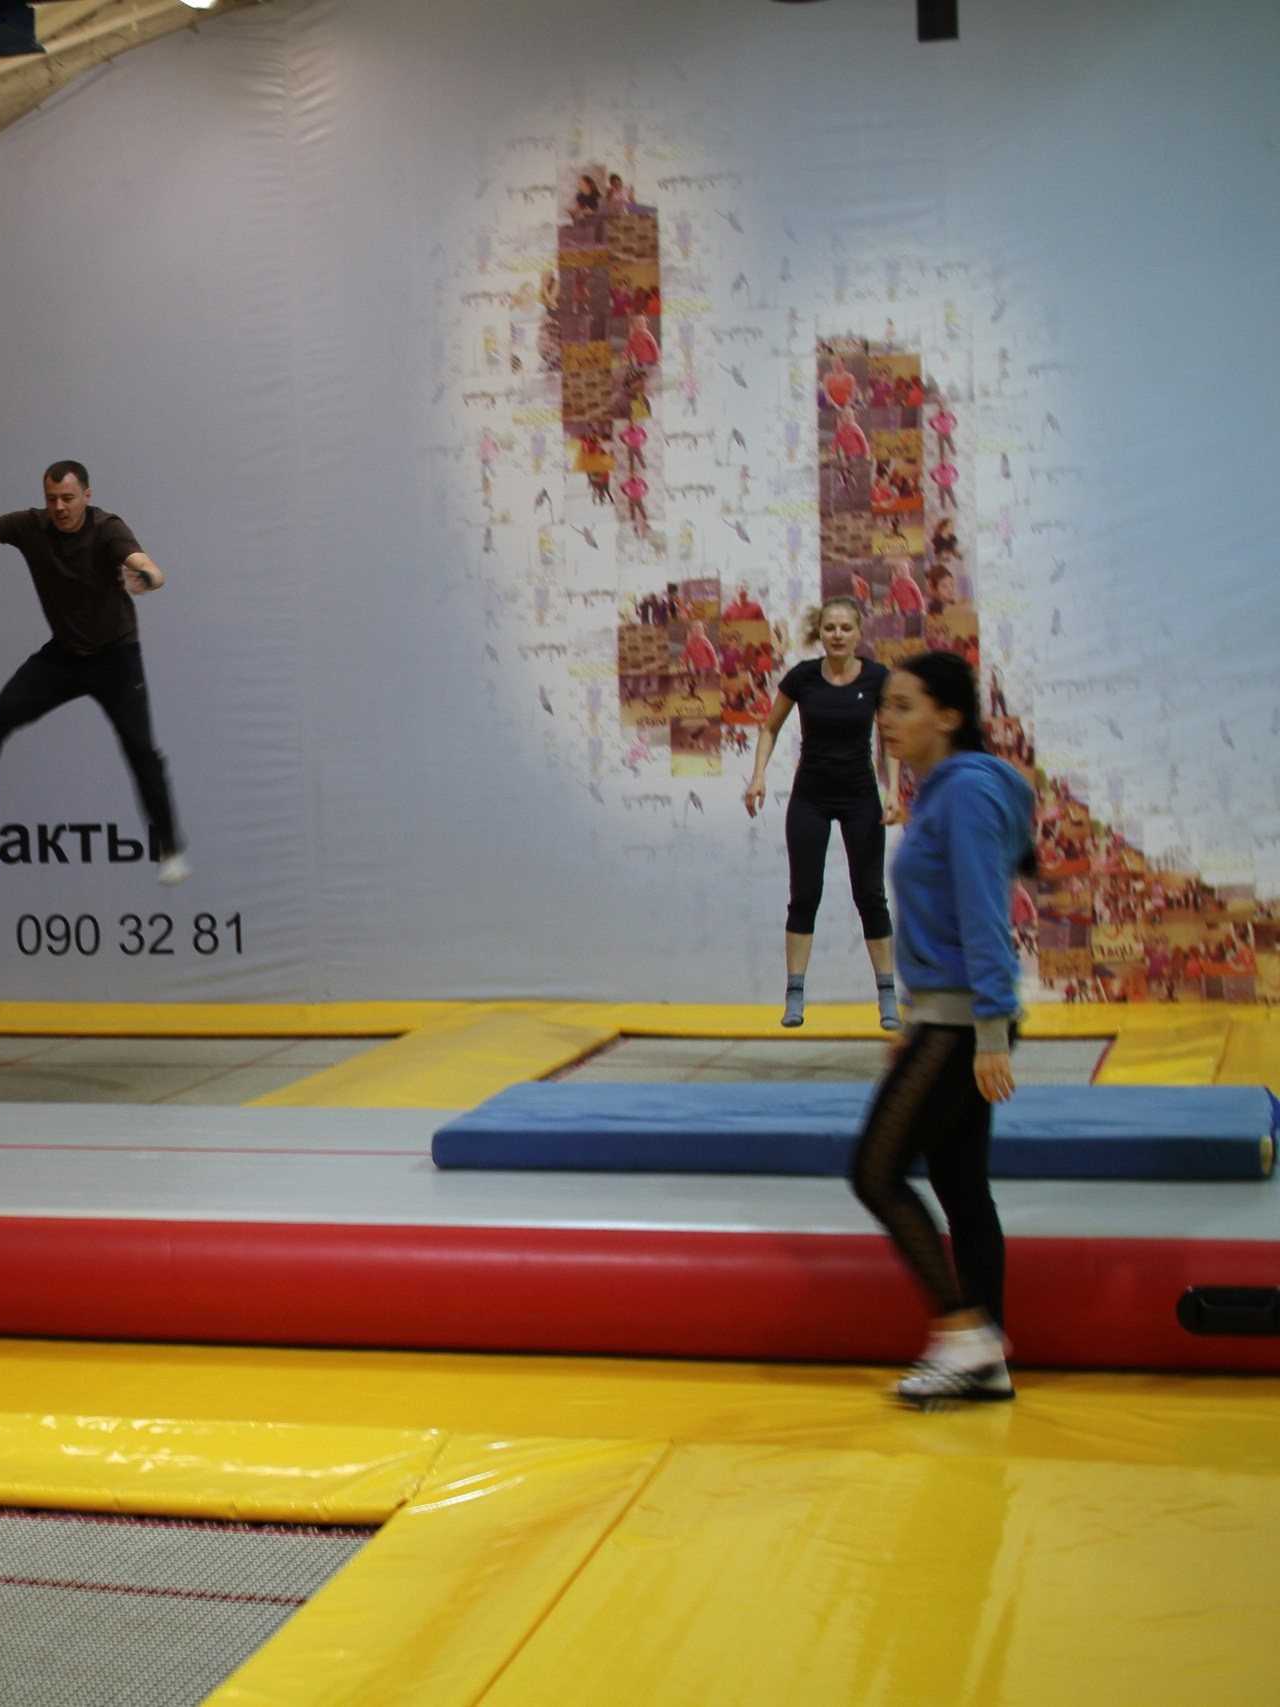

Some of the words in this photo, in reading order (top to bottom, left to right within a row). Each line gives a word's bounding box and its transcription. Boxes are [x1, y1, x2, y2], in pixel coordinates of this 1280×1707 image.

[16, 914, 101, 956] 090
[119, 913, 175, 956] 32
[193, 911, 243, 955] 81
